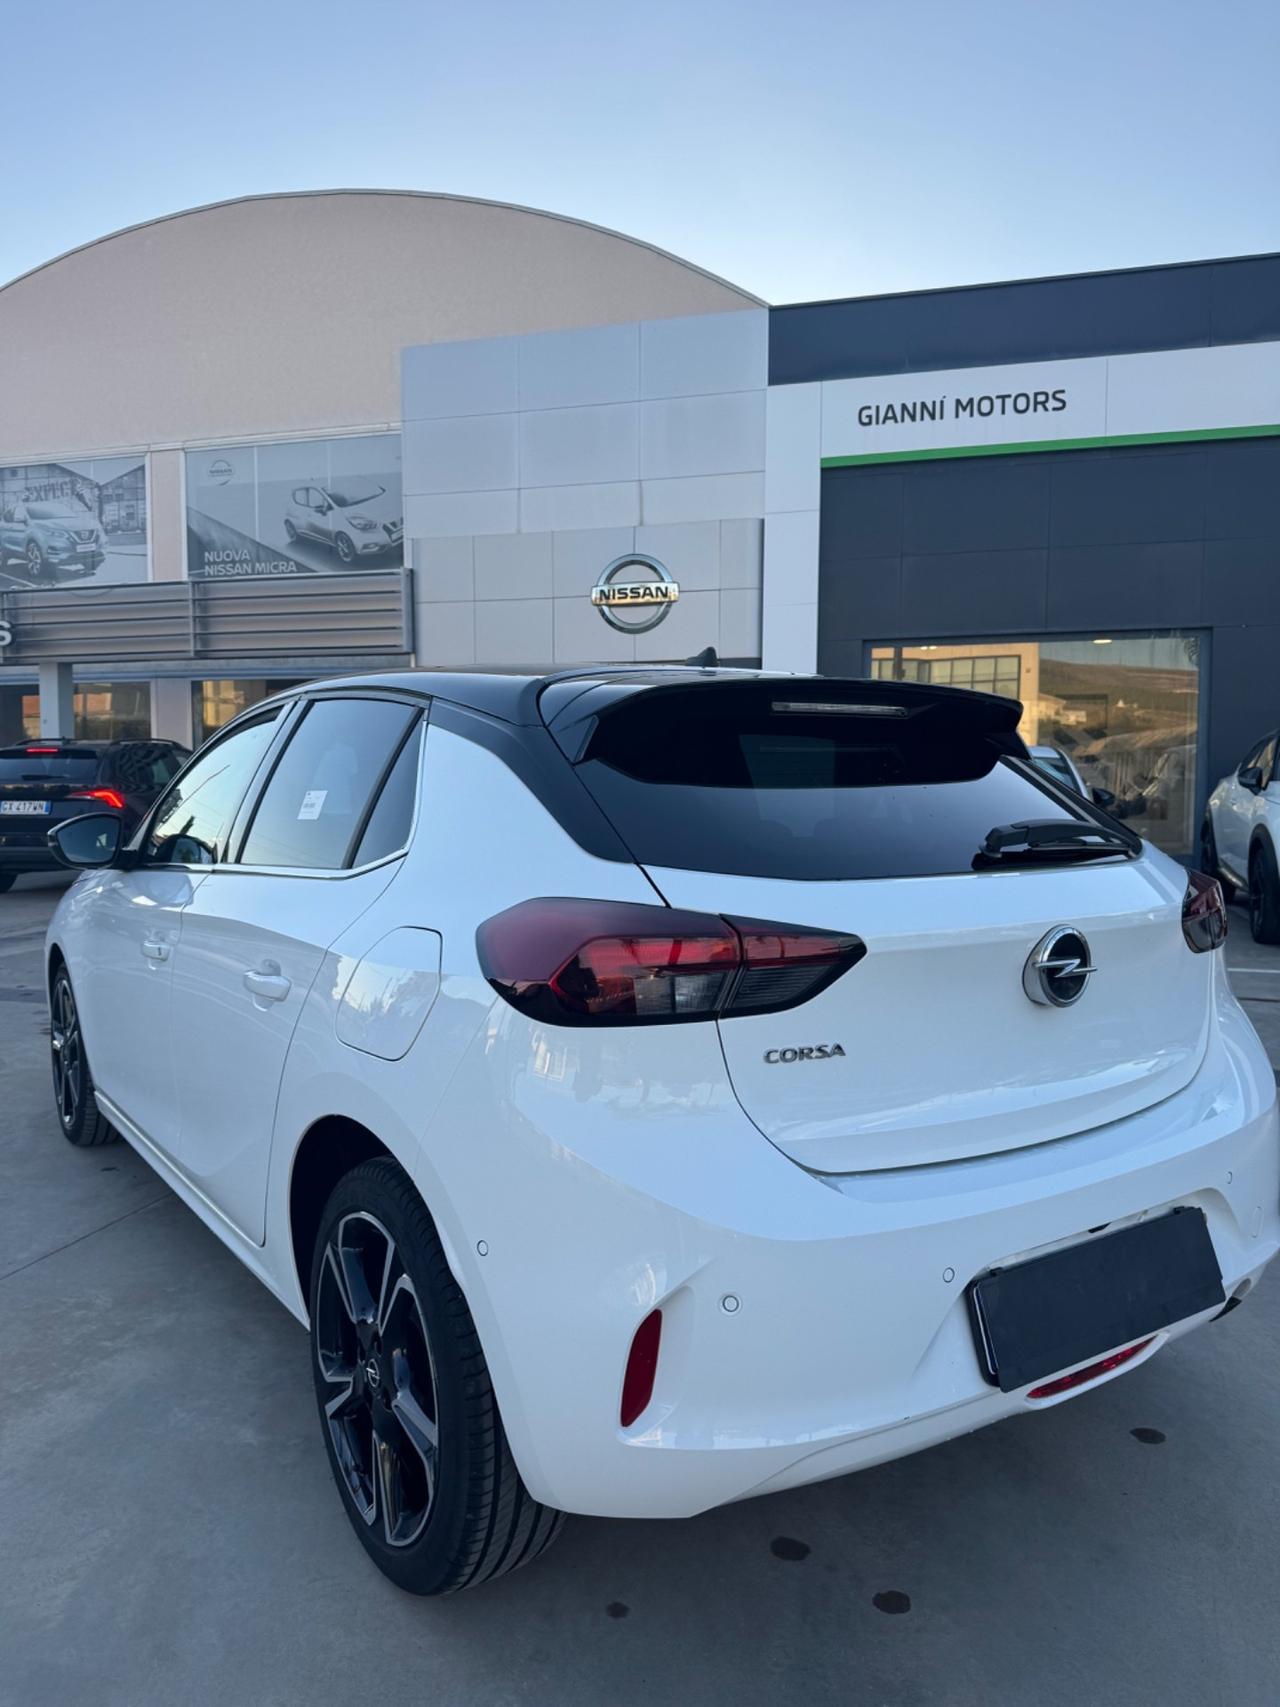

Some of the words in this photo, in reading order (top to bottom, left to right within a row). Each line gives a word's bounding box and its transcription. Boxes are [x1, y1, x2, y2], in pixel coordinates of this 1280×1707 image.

[954, 389, 1067, 419] MOTORS
[204, 549, 250, 563] NUOVA
[204, 562, 252, 576] NISSAN
[254, 561, 298, 574] MICRA
[599, 586, 669, 602] NISSAN
[763, 1043, 846, 1064] CORSA
